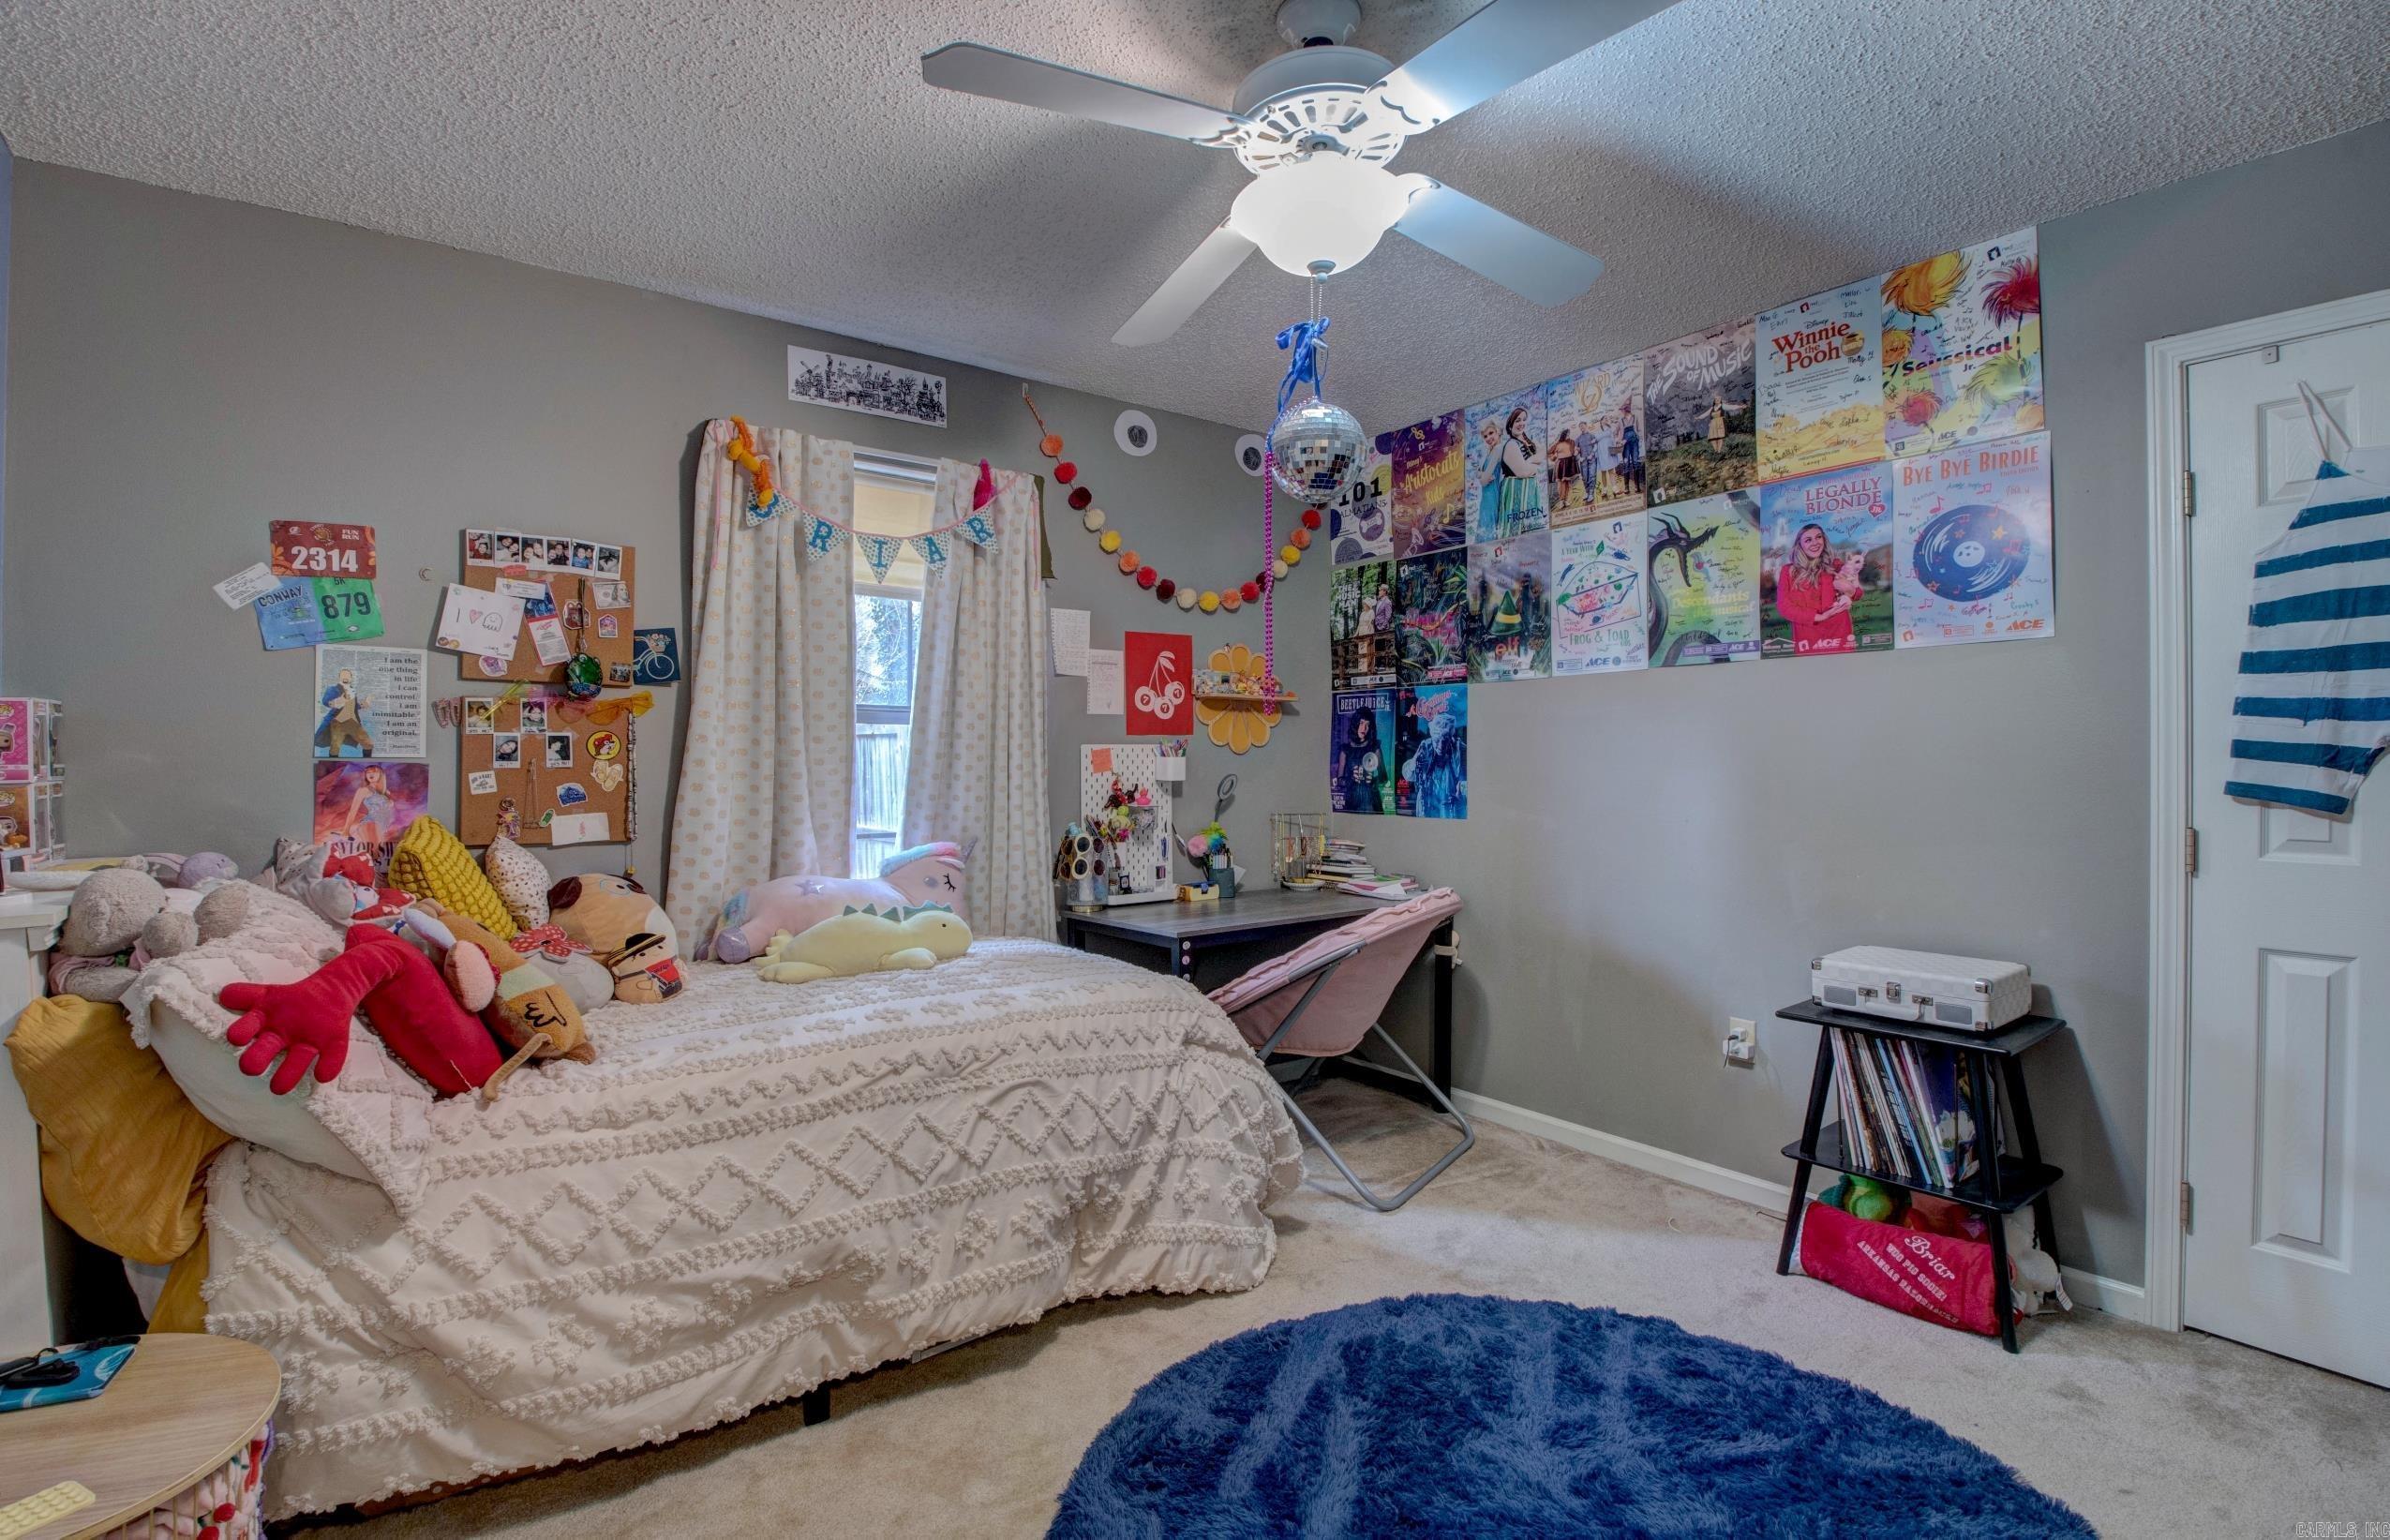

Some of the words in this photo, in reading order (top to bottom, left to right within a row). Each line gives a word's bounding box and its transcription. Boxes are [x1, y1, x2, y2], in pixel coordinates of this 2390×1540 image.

[1771, 321, 1850, 354] Winnie
[1804, 344, 1820, 354] the
[1697, 337, 1753, 392] MUSIC
[1785, 340, 1841, 374] Pooh
[1902, 336, 2013, 377] Seussical
[1662, 345, 1719, 396] SOUND
[1687, 368, 1701, 384] OF
[1646, 375, 1665, 406] THE
[1938, 430, 1958, 441] ACE
[1904, 465, 1933, 486] BYE
[1940, 458, 1972, 480] BYE
[1979, 445, 2039, 473] BIRDIE
[1338, 477, 1382, 507] 101
[1805, 476, 1882, 501] LEGALLY
[1338, 500, 1387, 518] ALMATIANS
[1507, 507, 1544, 523] FROZEN
[1805, 491, 1882, 516] BLONDE
[291, 546, 359, 573] 2314
[1566, 546, 1578, 555] YEAR
[1579, 545, 1593, 553] WITH
[258, 585, 304, 607] CONWAY
[321, 591, 371, 620] 879
[1569, 633, 1591, 645] FROG
[1593, 631, 1603, 643] &
[1607, 629, 1630, 641] TOAD
[2006, 619, 2045, 631] ACE
[1813, 638, 1842, 648] ACE
[396, 666, 419, 675] thing
[1586, 657, 1611, 666] ACE
[1857, 1240, 1901, 1282] ARKANSAS
[1886, 1243, 1905, 1263] WOO
[1902, 1259, 1919, 1276] PIG
[1904, 1235, 1956, 1280] Briar
